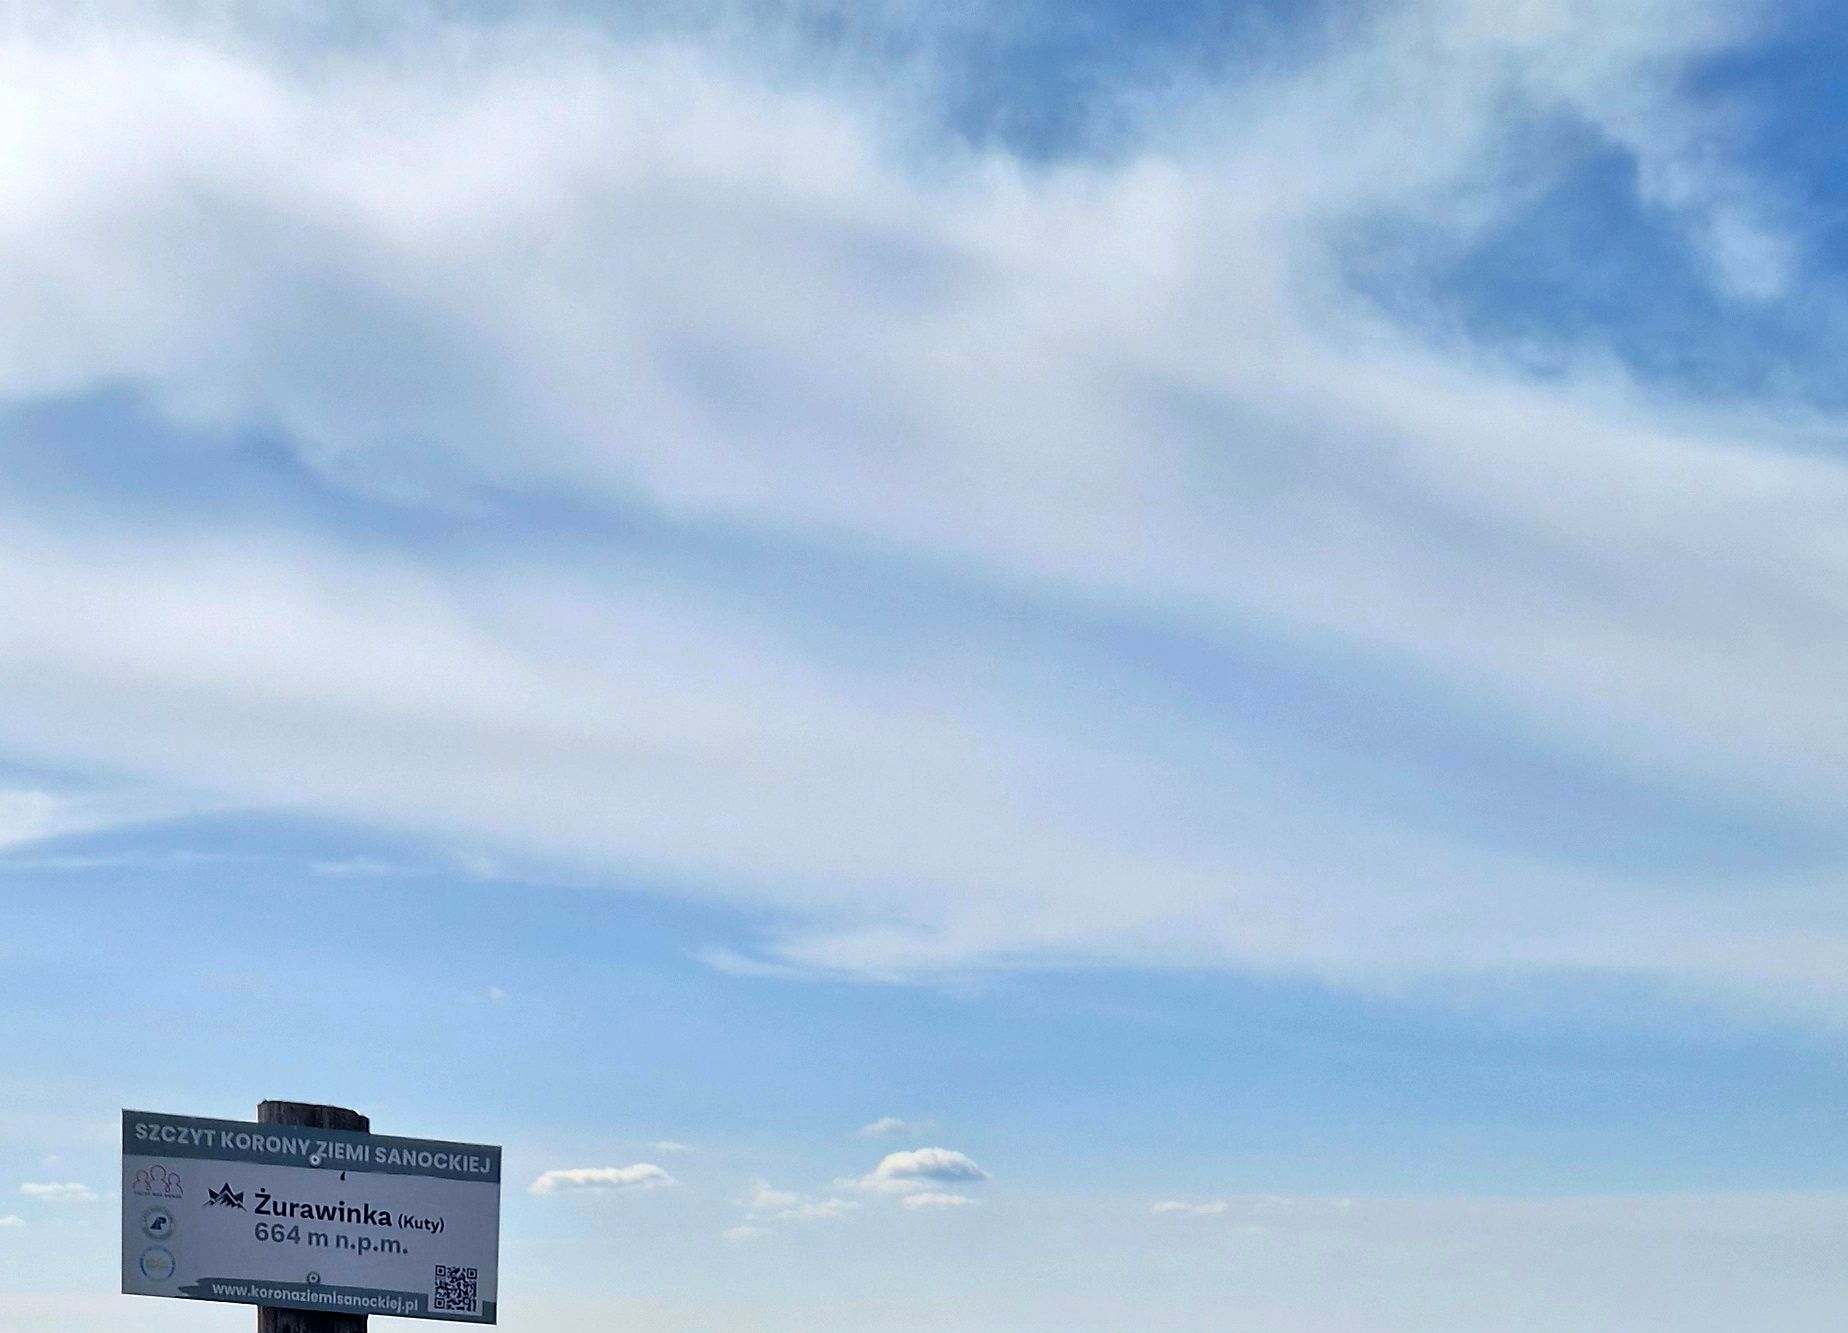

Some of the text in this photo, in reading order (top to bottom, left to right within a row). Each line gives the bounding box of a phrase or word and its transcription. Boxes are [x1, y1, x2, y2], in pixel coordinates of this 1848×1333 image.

[135, 1122, 491, 1174] SZCZYT KORONY ZIEMI SANOCKIEJ
[254, 1187, 445, 1234] Żurawinka (Kuty)
[253, 1222, 409, 1256] 664 m n.p.m.
[212, 1281, 418, 1313] www.koronaziemisanockiej.pl
